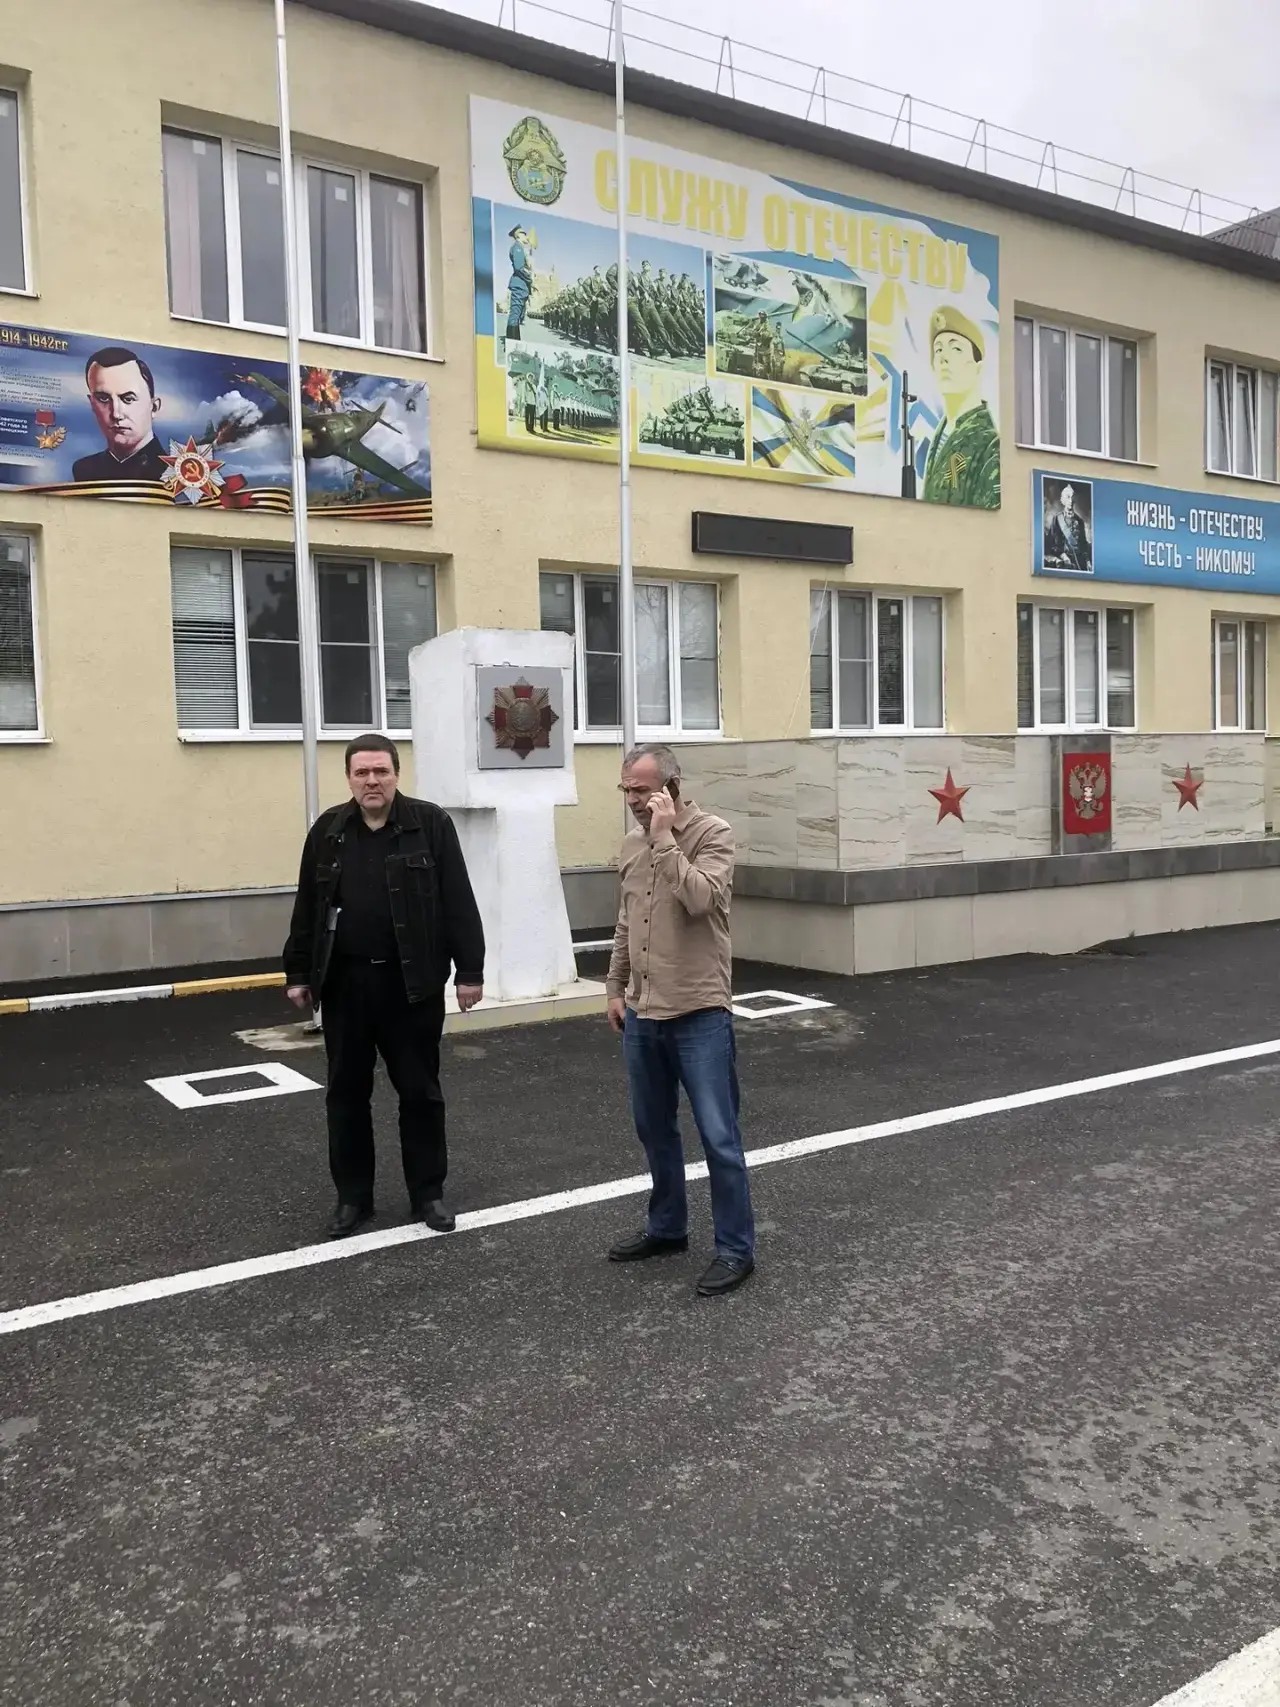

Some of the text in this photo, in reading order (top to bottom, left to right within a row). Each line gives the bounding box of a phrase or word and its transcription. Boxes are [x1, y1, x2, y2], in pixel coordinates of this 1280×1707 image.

[595, 149, 749, 241] СЛУЖУ
[763, 193, 968, 293] ОТЕЧЕСТВУ
[0, 329, 69, 351] 914-1942гг
[1126, 500, 1176, 531] ЖИЗНЬ
[1189, 508, 1266, 542] ОТЕЧЕСТВУ,
[1139, 540, 1182, 569] ЧЕСТЬ
[1196, 546, 1255, 575] НИКОМУ!
